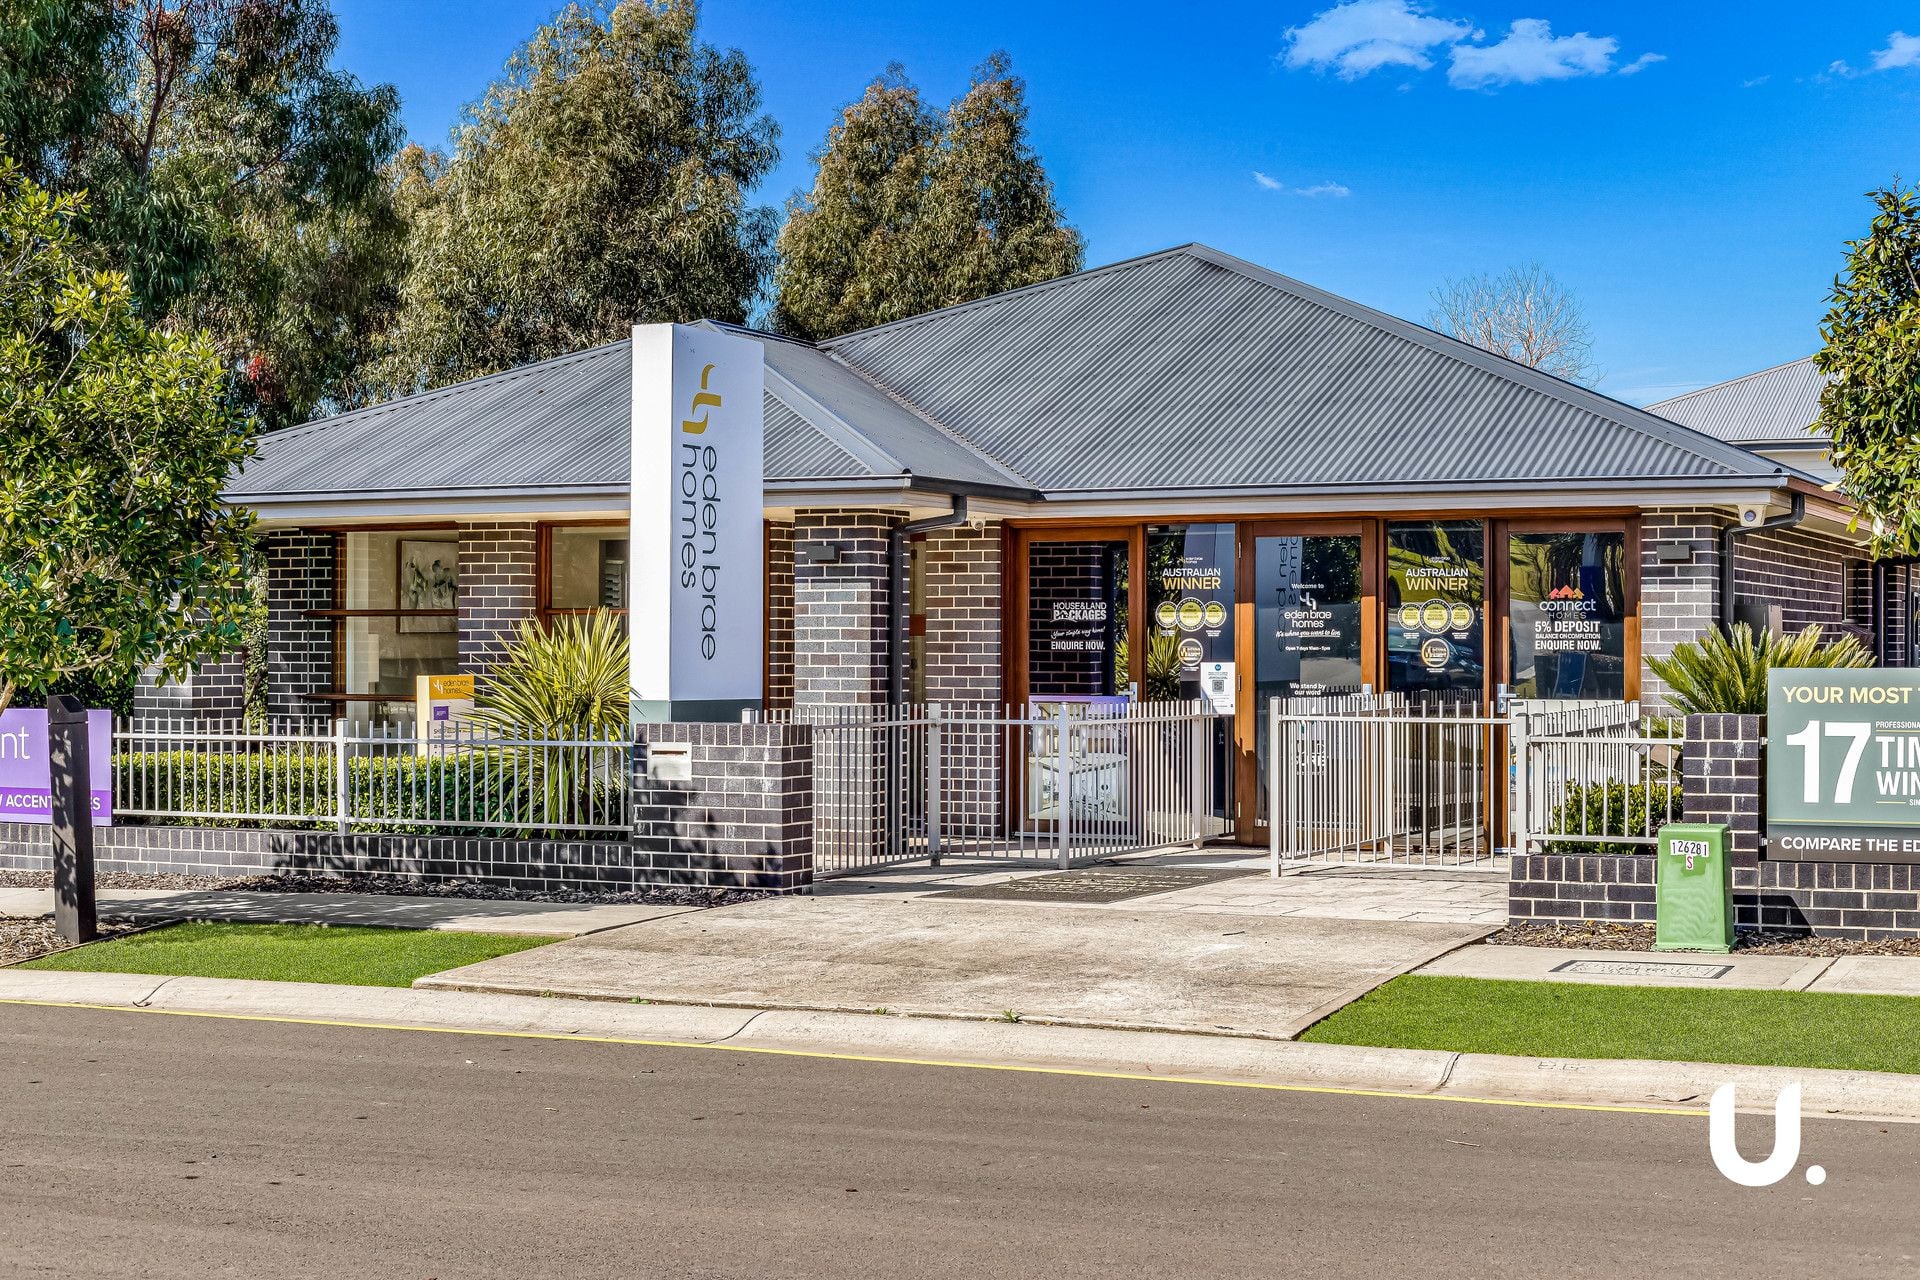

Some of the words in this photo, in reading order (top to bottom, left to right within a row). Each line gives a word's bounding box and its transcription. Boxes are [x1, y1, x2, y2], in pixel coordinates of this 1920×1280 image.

[701, 445, 721, 554] eden
[681, 443, 702, 589] homes
[1162, 567, 1221, 577] AUSTRALIAN
[1405, 568, 1469, 577] AUSTRALIAN
[1162, 577, 1221, 590] WINNER
[1405, 577, 1469, 591] WINNER
[1053, 602, 1107, 610] HOUSE&LAND
[1539, 598, 1597, 611] connect
[701, 565, 721, 661] brae
[1284, 610, 1309, 619] eden
[1310, 610, 1332, 619] brae
[1548, 611, 1587, 620] HOMES
[1291, 619, 1325, 628] homes
[1535, 621, 1552, 633] 5%
[1554, 620, 1601, 633] DEPOSIT
[1051, 641, 1084, 650] ENQUIRE
[1085, 641, 1106, 650] NOW.
[1535, 641, 1575, 650] ENQUIRE
[1577, 640, 1602, 650] NOW.
[1319, 682, 1327, 690] by
[1783, 687, 1844, 704] YOUR
[1850, 687, 1913, 704] MOST
[1786, 720, 1872, 804] 17
[1671, 840, 1708, 857] 126281
[1780, 836, 1862, 850] COMPARE
[1866, 838, 1898, 852] THE
[1686, 856, 1693, 869] S
